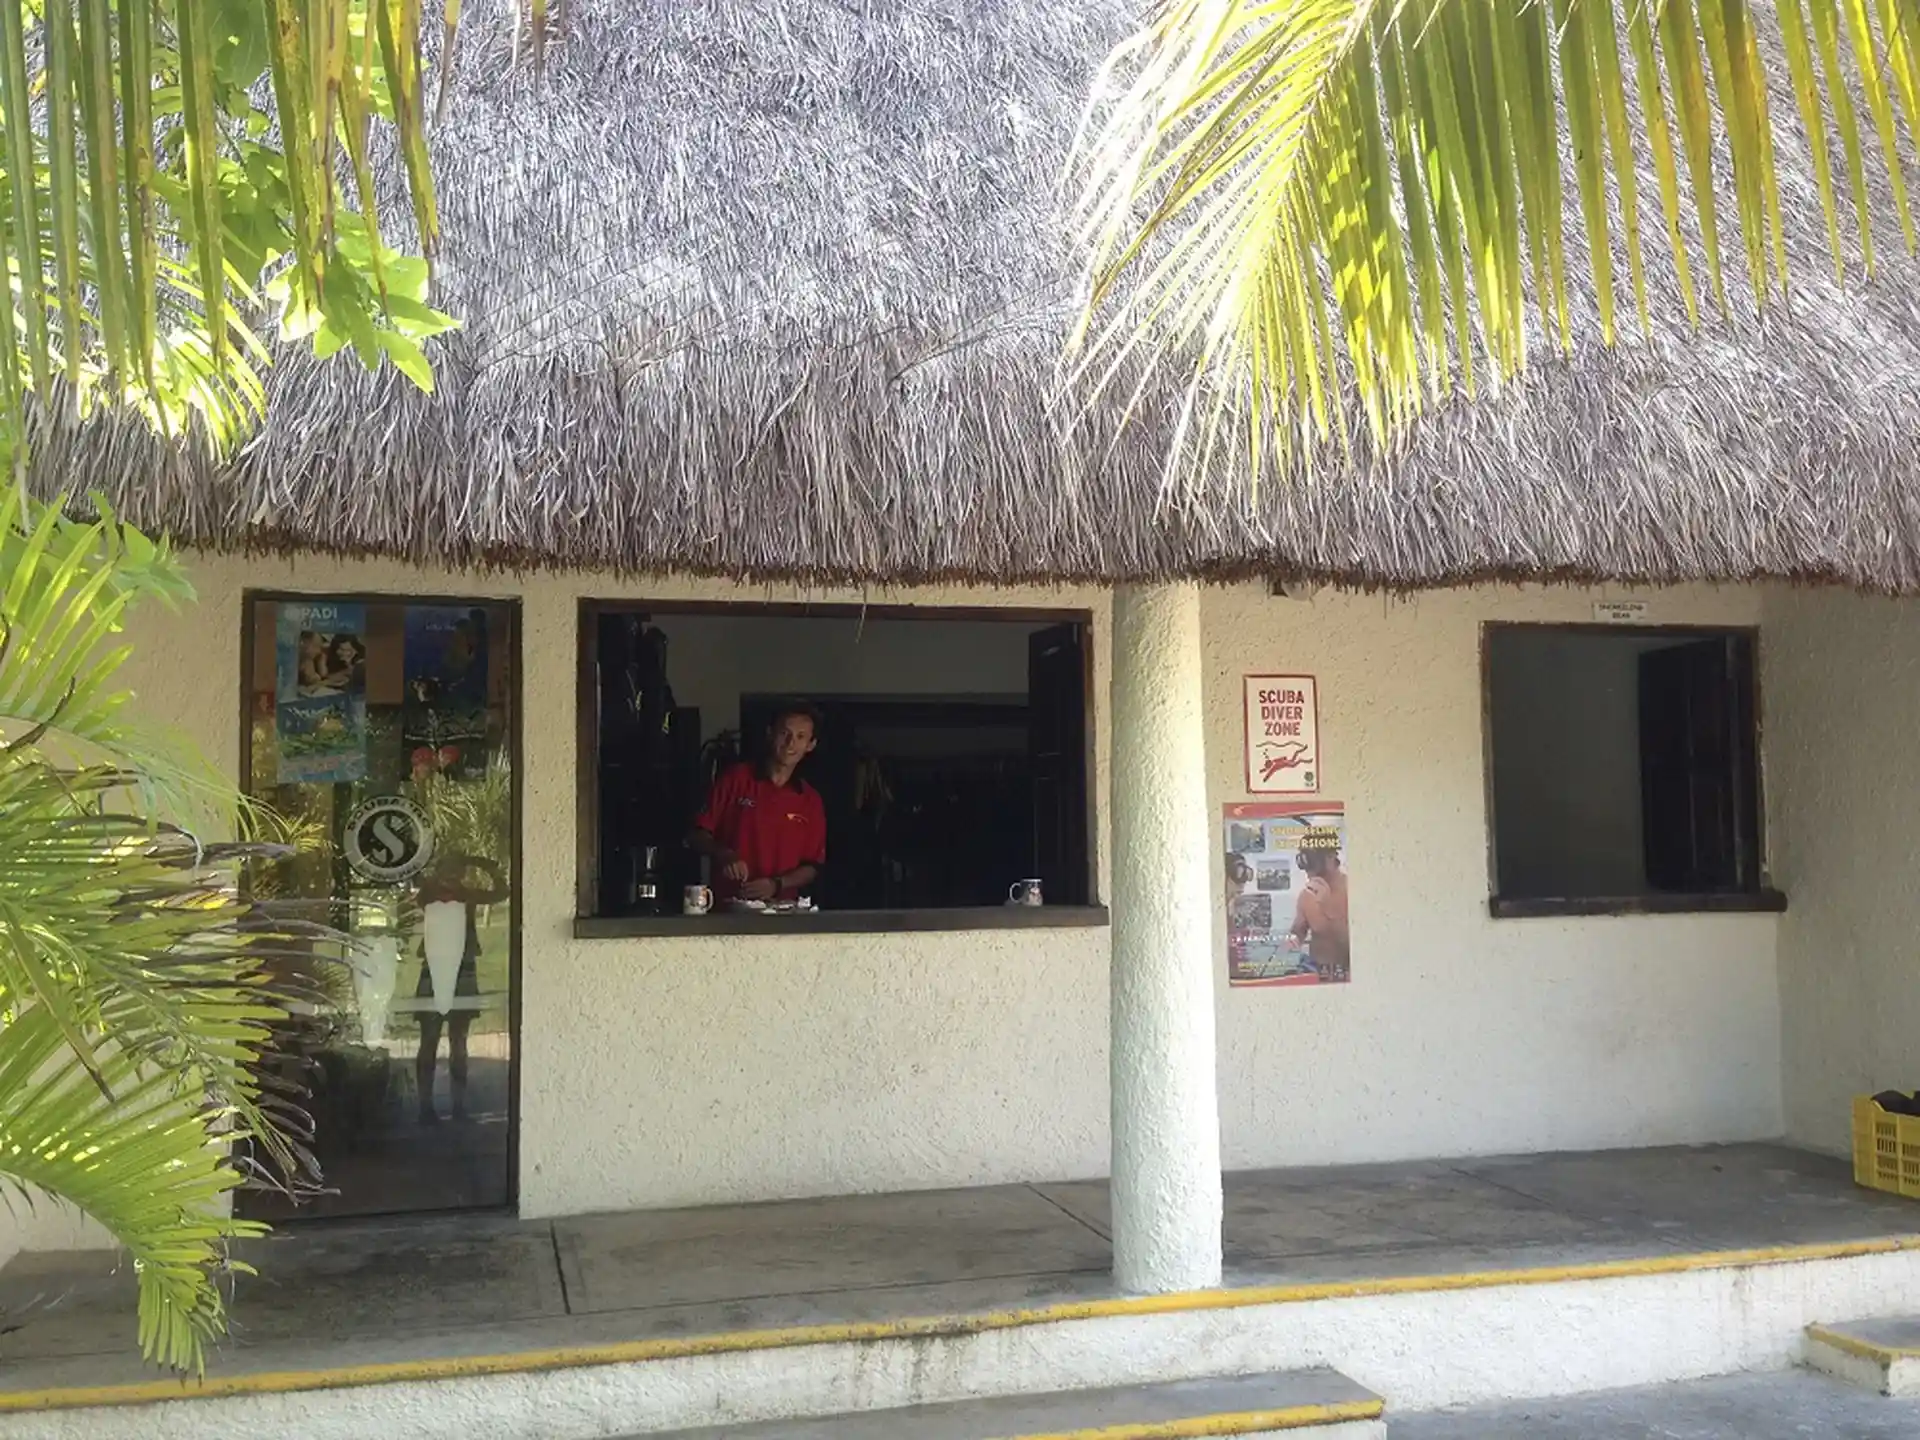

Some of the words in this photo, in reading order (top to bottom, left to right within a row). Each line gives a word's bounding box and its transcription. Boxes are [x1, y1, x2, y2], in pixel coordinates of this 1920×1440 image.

[301, 606, 338, 619] PADI
[1259, 689, 1305, 704] SCUBA
[1261, 706, 1303, 720] DIVER
[1264, 722, 1301, 736] ZONE
